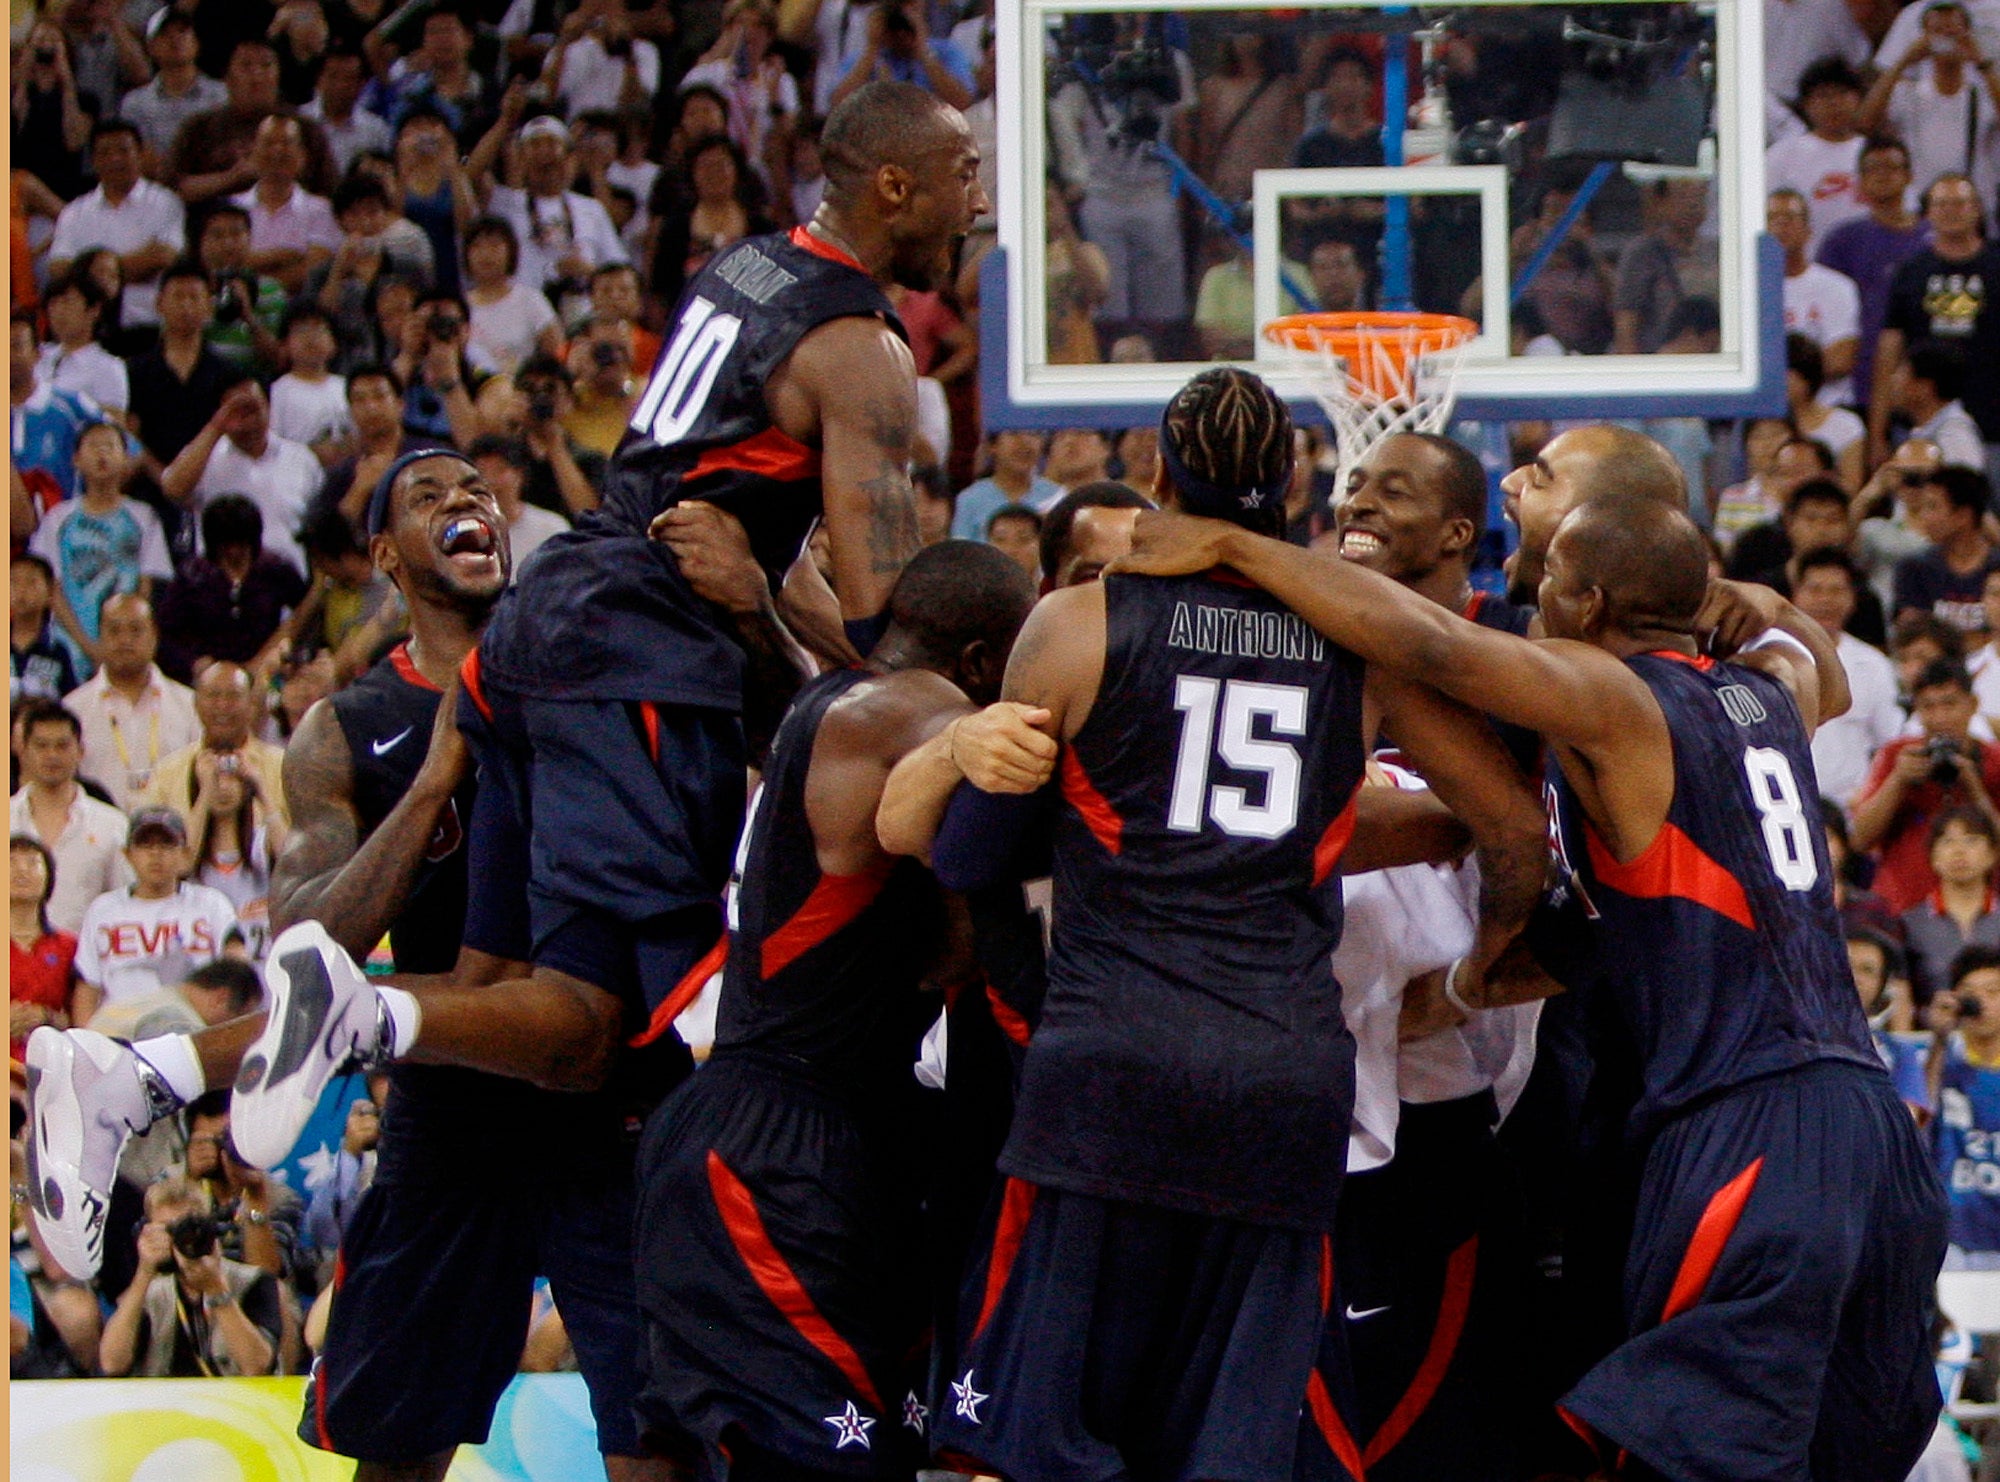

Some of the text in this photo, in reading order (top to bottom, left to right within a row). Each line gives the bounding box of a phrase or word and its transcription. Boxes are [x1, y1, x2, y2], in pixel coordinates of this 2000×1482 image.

[714, 244, 798, 304] BRYANT
[630, 295, 742, 446] 10
[1167, 674, 1309, 840] 15
[1743, 745, 1819, 892] 8
